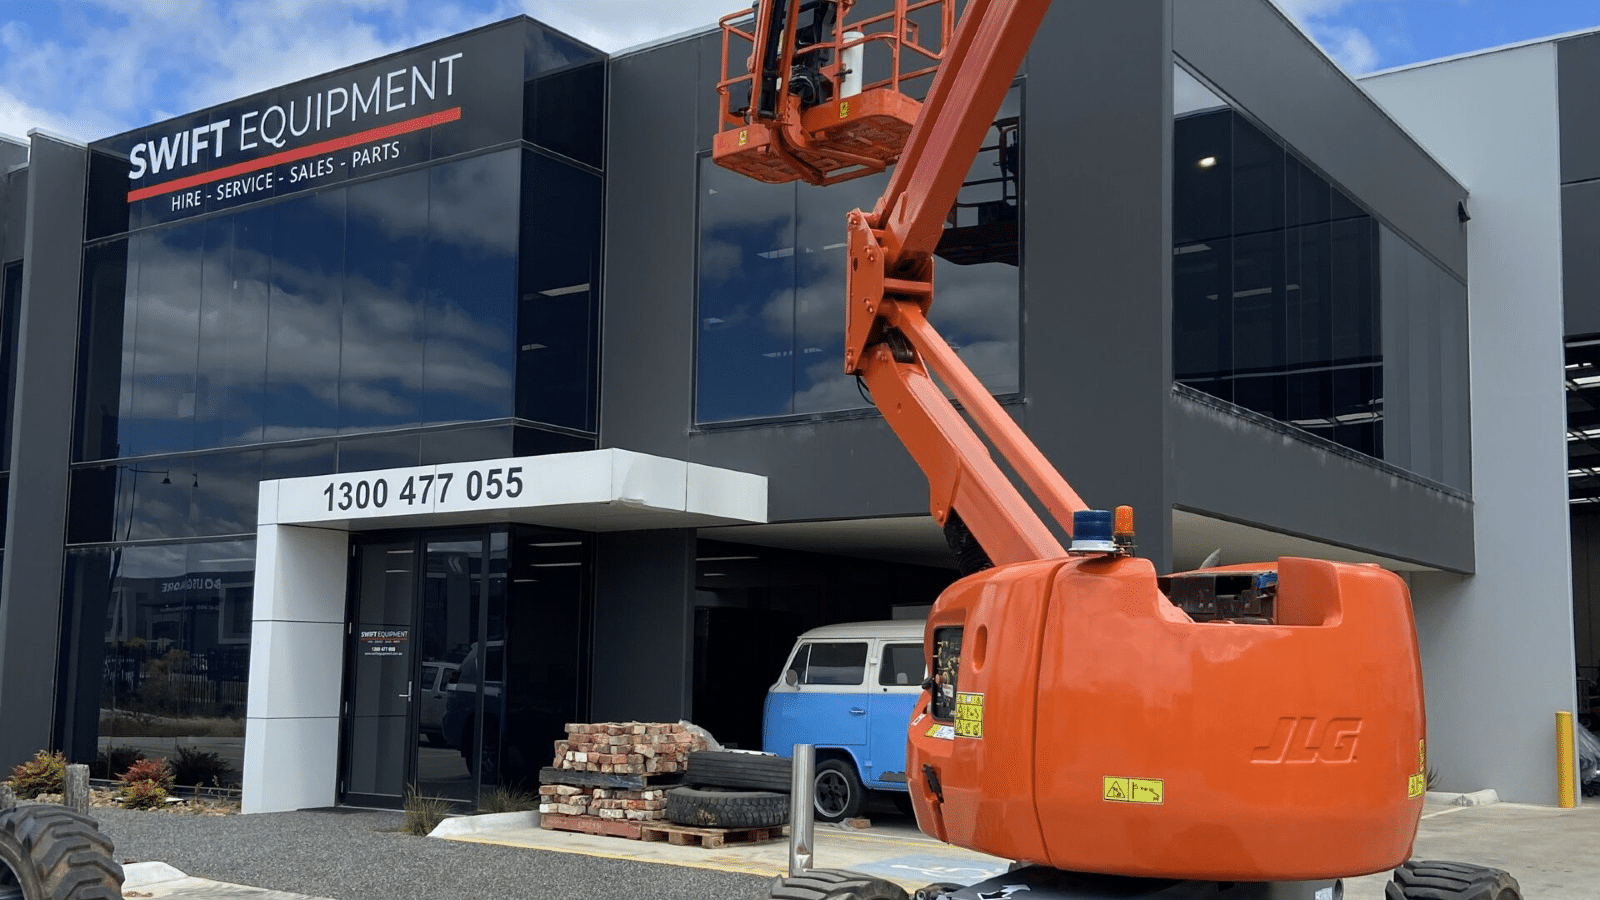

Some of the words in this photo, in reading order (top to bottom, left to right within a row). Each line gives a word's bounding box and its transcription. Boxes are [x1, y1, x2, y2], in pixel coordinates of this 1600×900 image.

[128, 118, 230, 179] SWIFT
[240, 52, 463, 151] EQUIPMENT
[171, 190, 202, 212] HIRE
[216, 173, 273, 201] SERVICE
[290, 157, 334, 184] SALES
[352, 141, 400, 168] PARTS
[323, 478, 388, 512] 1300
[399, 472, 454, 506] 477
[466, 466, 524, 502] 055
[378, 630, 408, 638] EQUIPMENT
[1250, 716, 1363, 764] JLG
